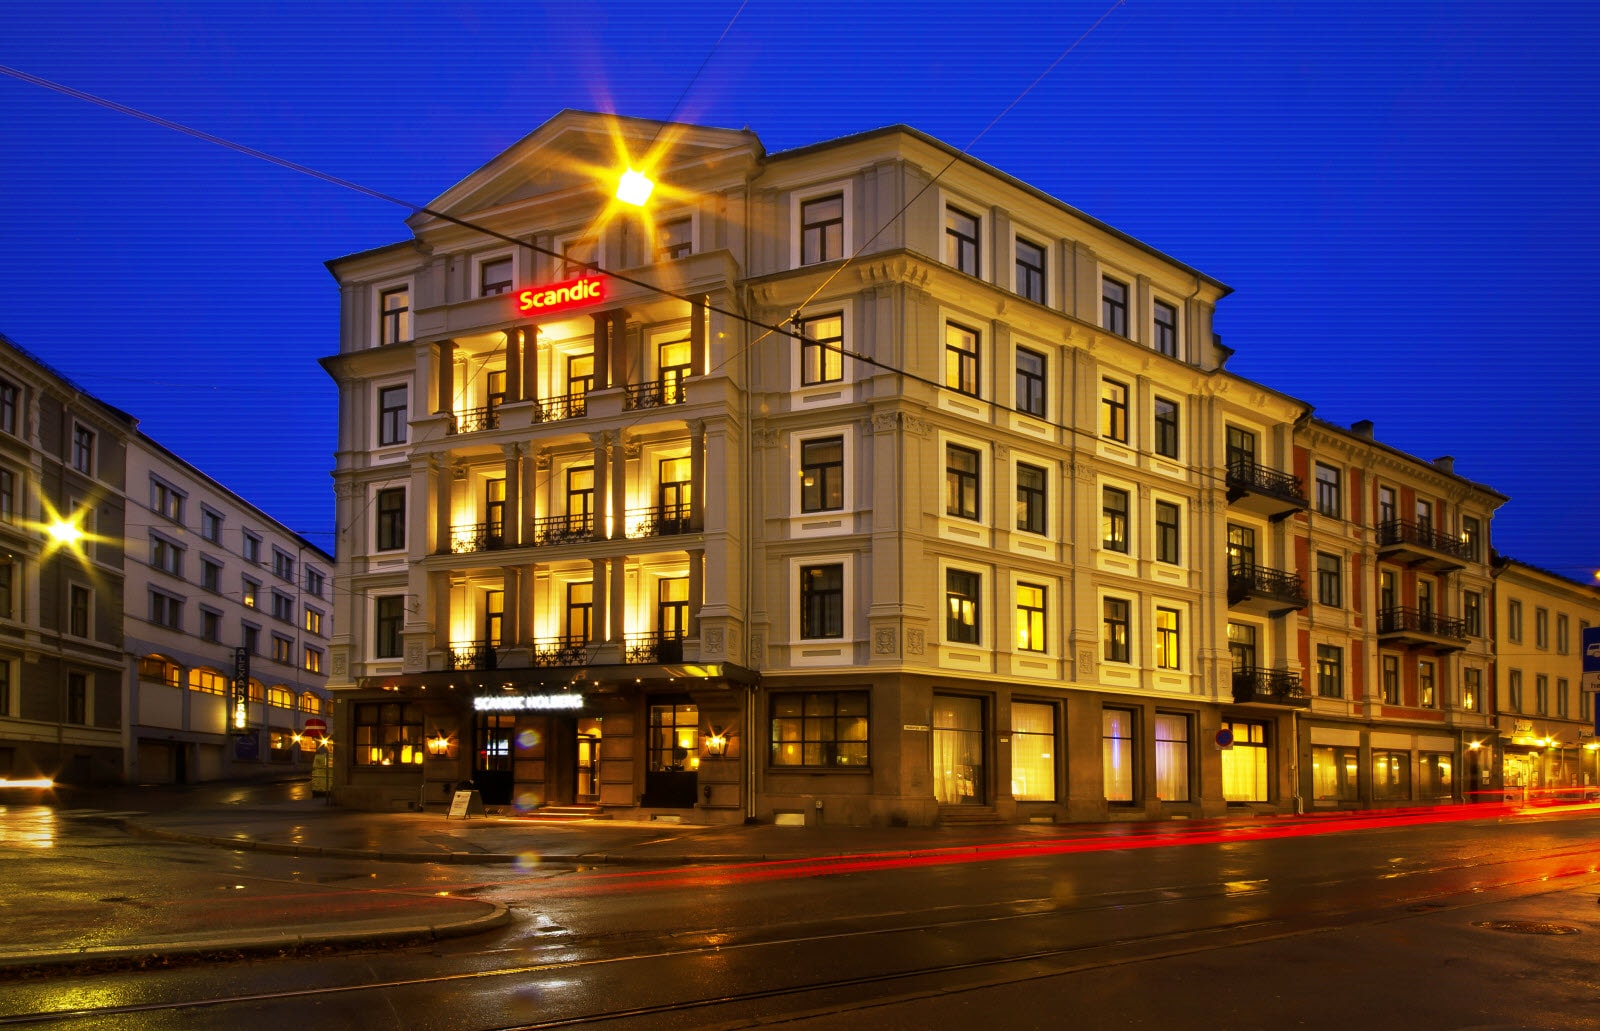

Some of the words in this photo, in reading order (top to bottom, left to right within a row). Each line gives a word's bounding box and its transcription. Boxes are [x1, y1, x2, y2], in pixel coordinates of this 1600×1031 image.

[520, 279, 600, 311] Scandic
[235, 648, 247, 728] ALEXANDROS
[474, 696, 525, 710] SCANDIC
[527, 694, 583, 709] HOLBERG
